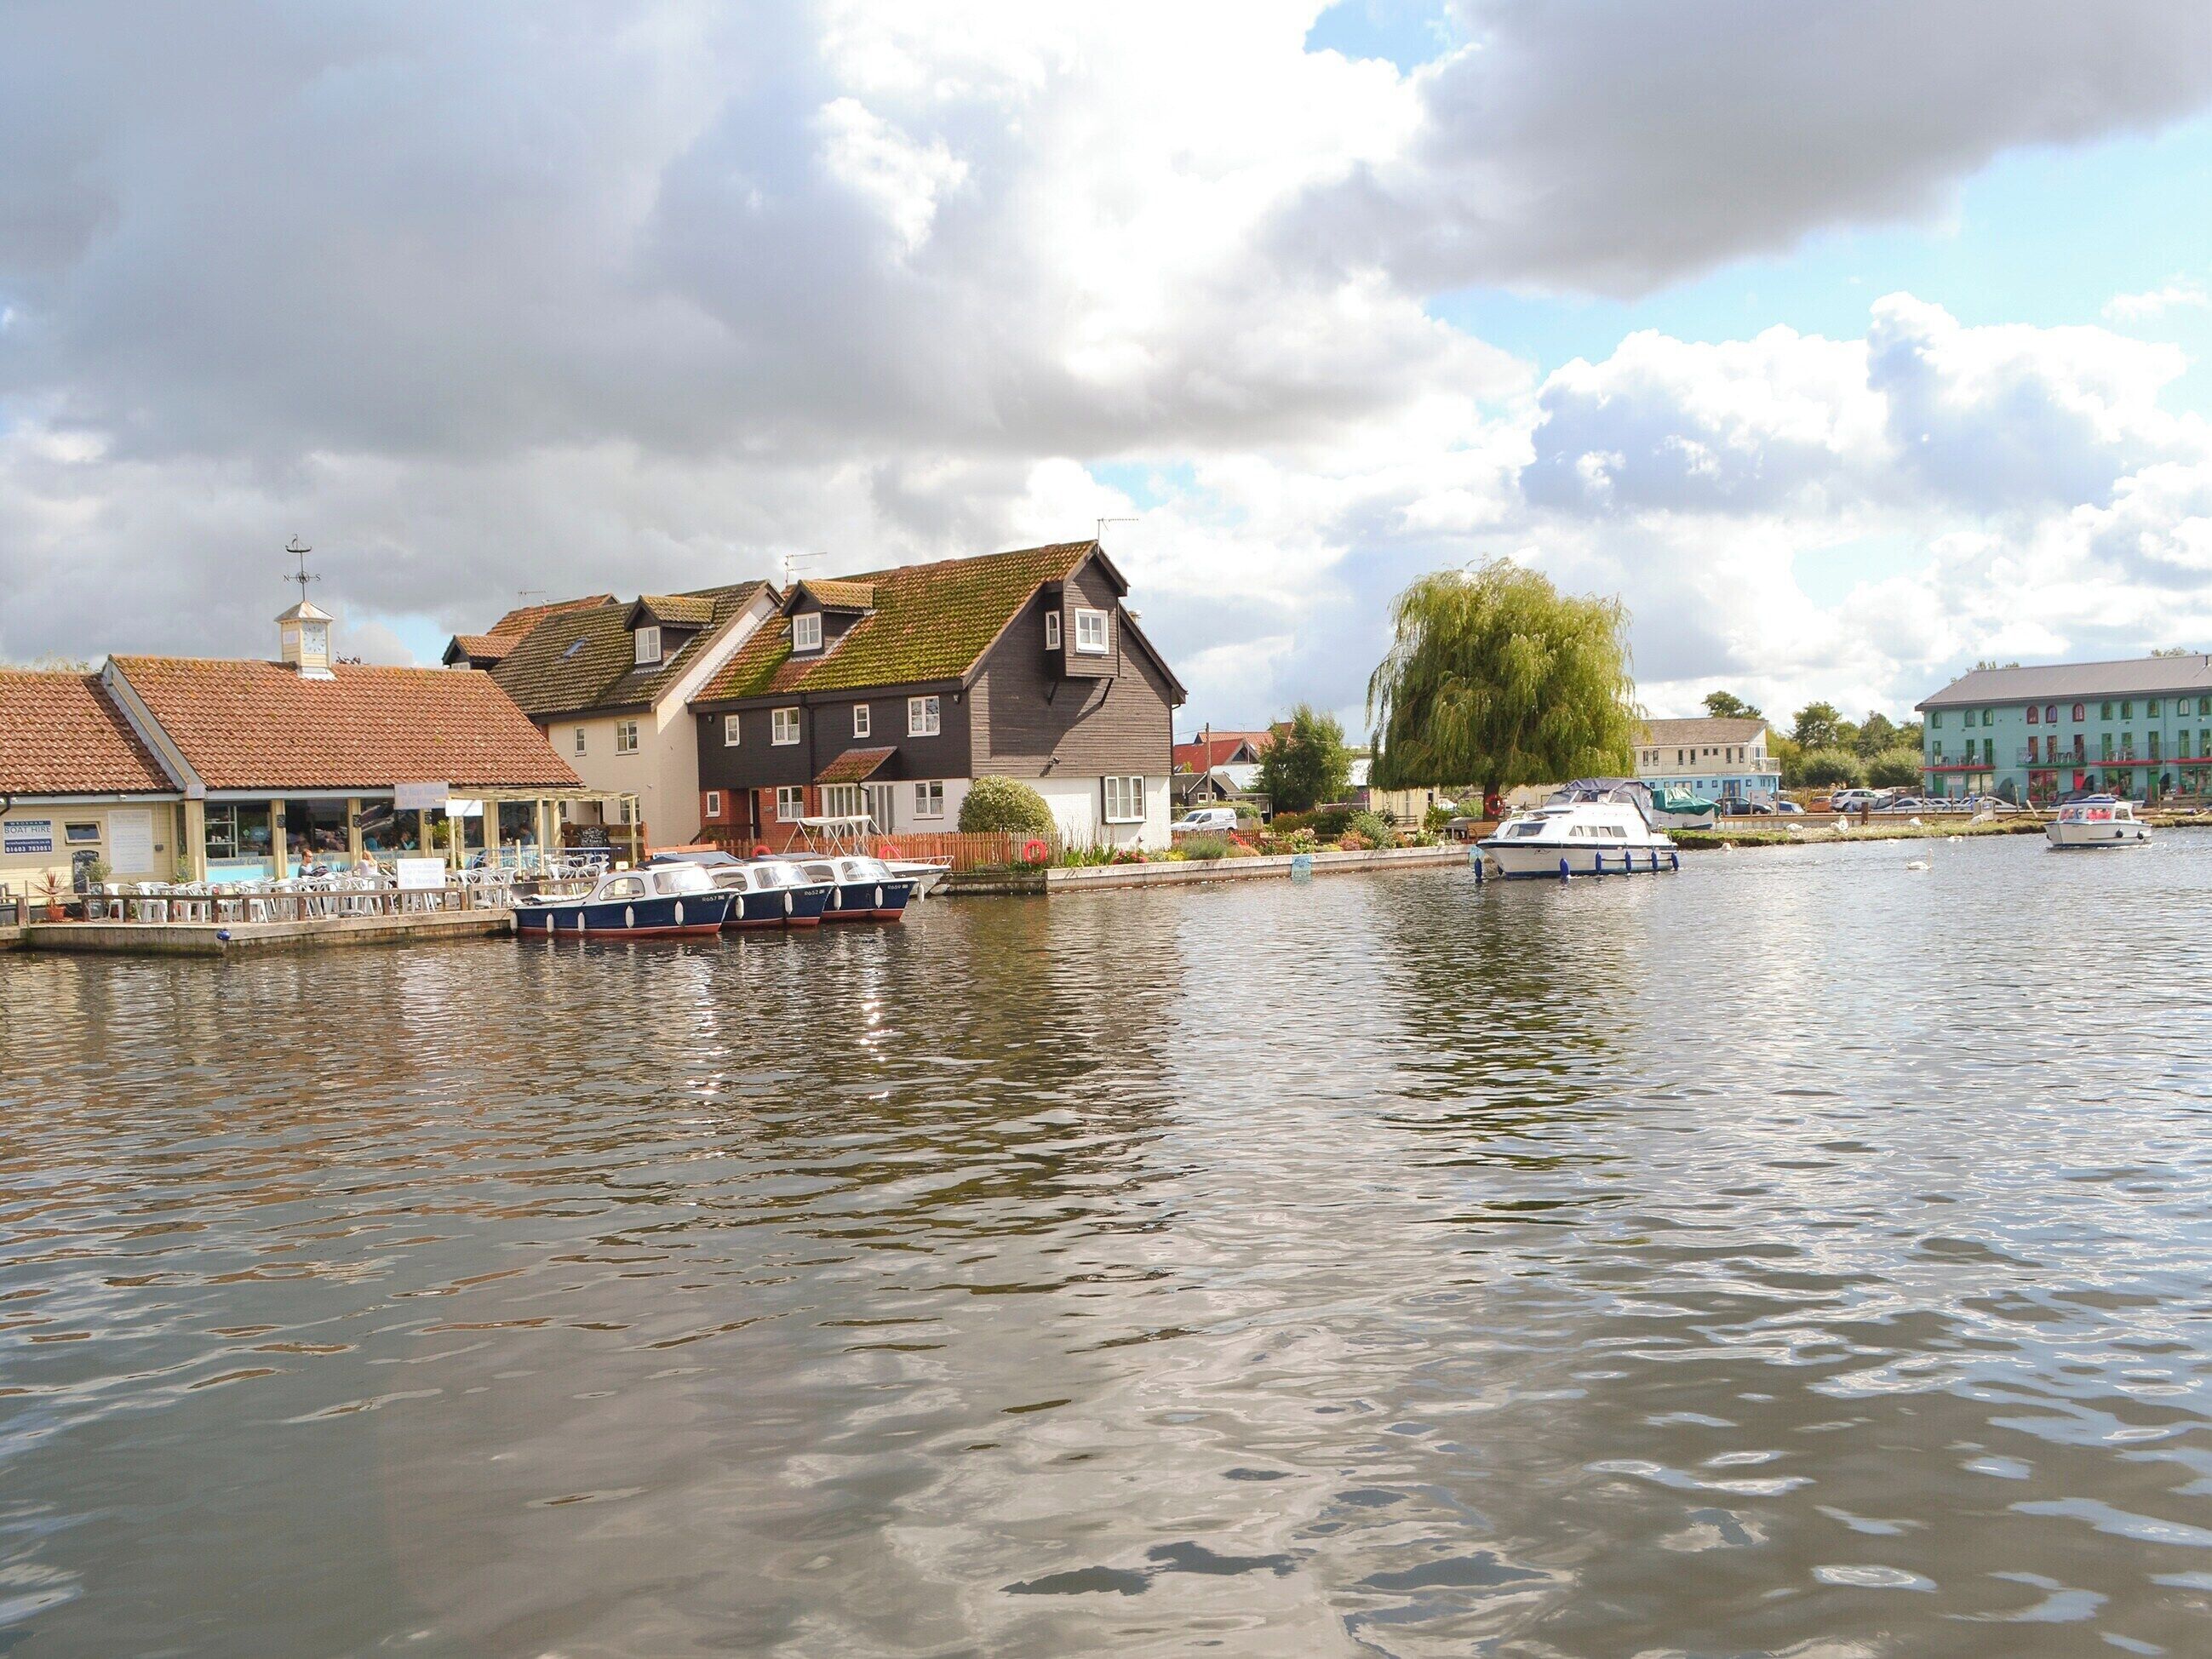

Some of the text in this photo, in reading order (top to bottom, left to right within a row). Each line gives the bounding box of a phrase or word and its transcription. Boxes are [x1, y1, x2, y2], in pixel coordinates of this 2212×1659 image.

[4, 825, 51, 834] BOAT HIRE
[207, 856, 267, 867] Homemade Cakes
